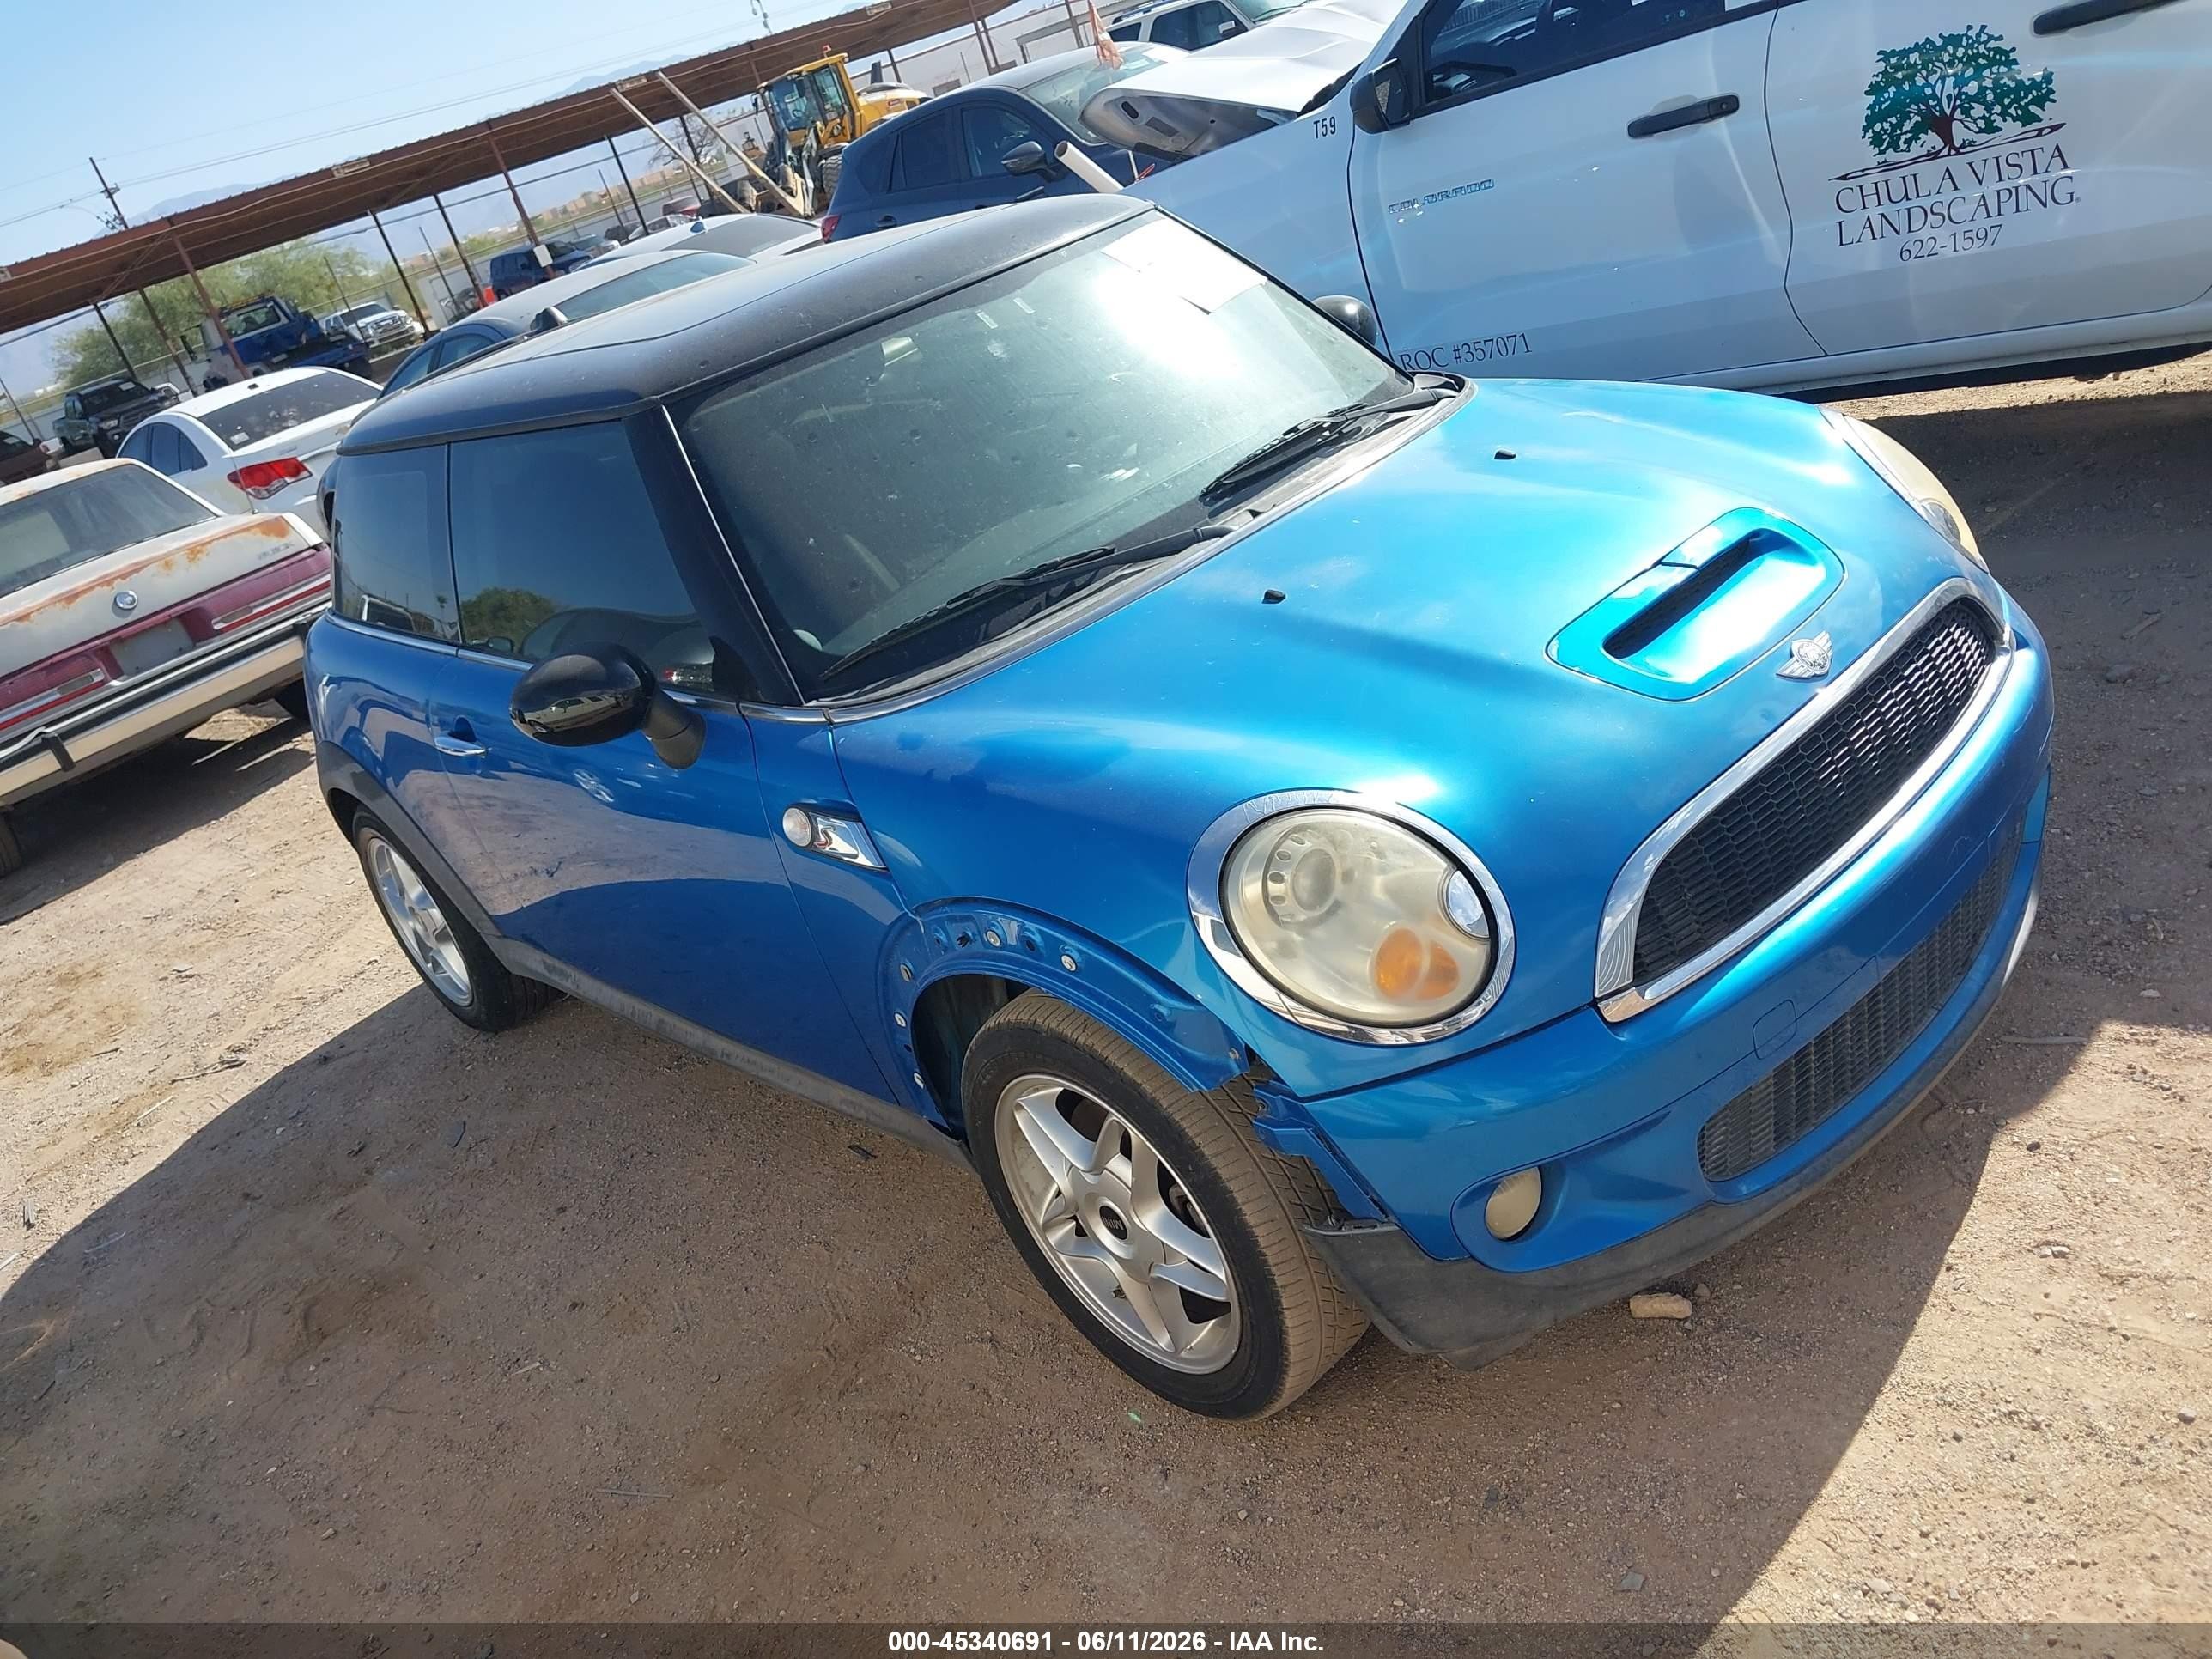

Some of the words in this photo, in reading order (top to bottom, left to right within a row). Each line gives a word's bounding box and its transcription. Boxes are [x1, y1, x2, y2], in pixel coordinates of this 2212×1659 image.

[1313, 116, 1336, 139] T59
[1388, 179, 1495, 214] COLORADO
[1835, 165, 1960, 214] CHULA
[1966, 143, 2071, 187] VISTA
[1899, 223, 2003, 262] 622-1597
[1398, 347, 1449, 371] ROC
[1452, 332, 1533, 365] #357071
